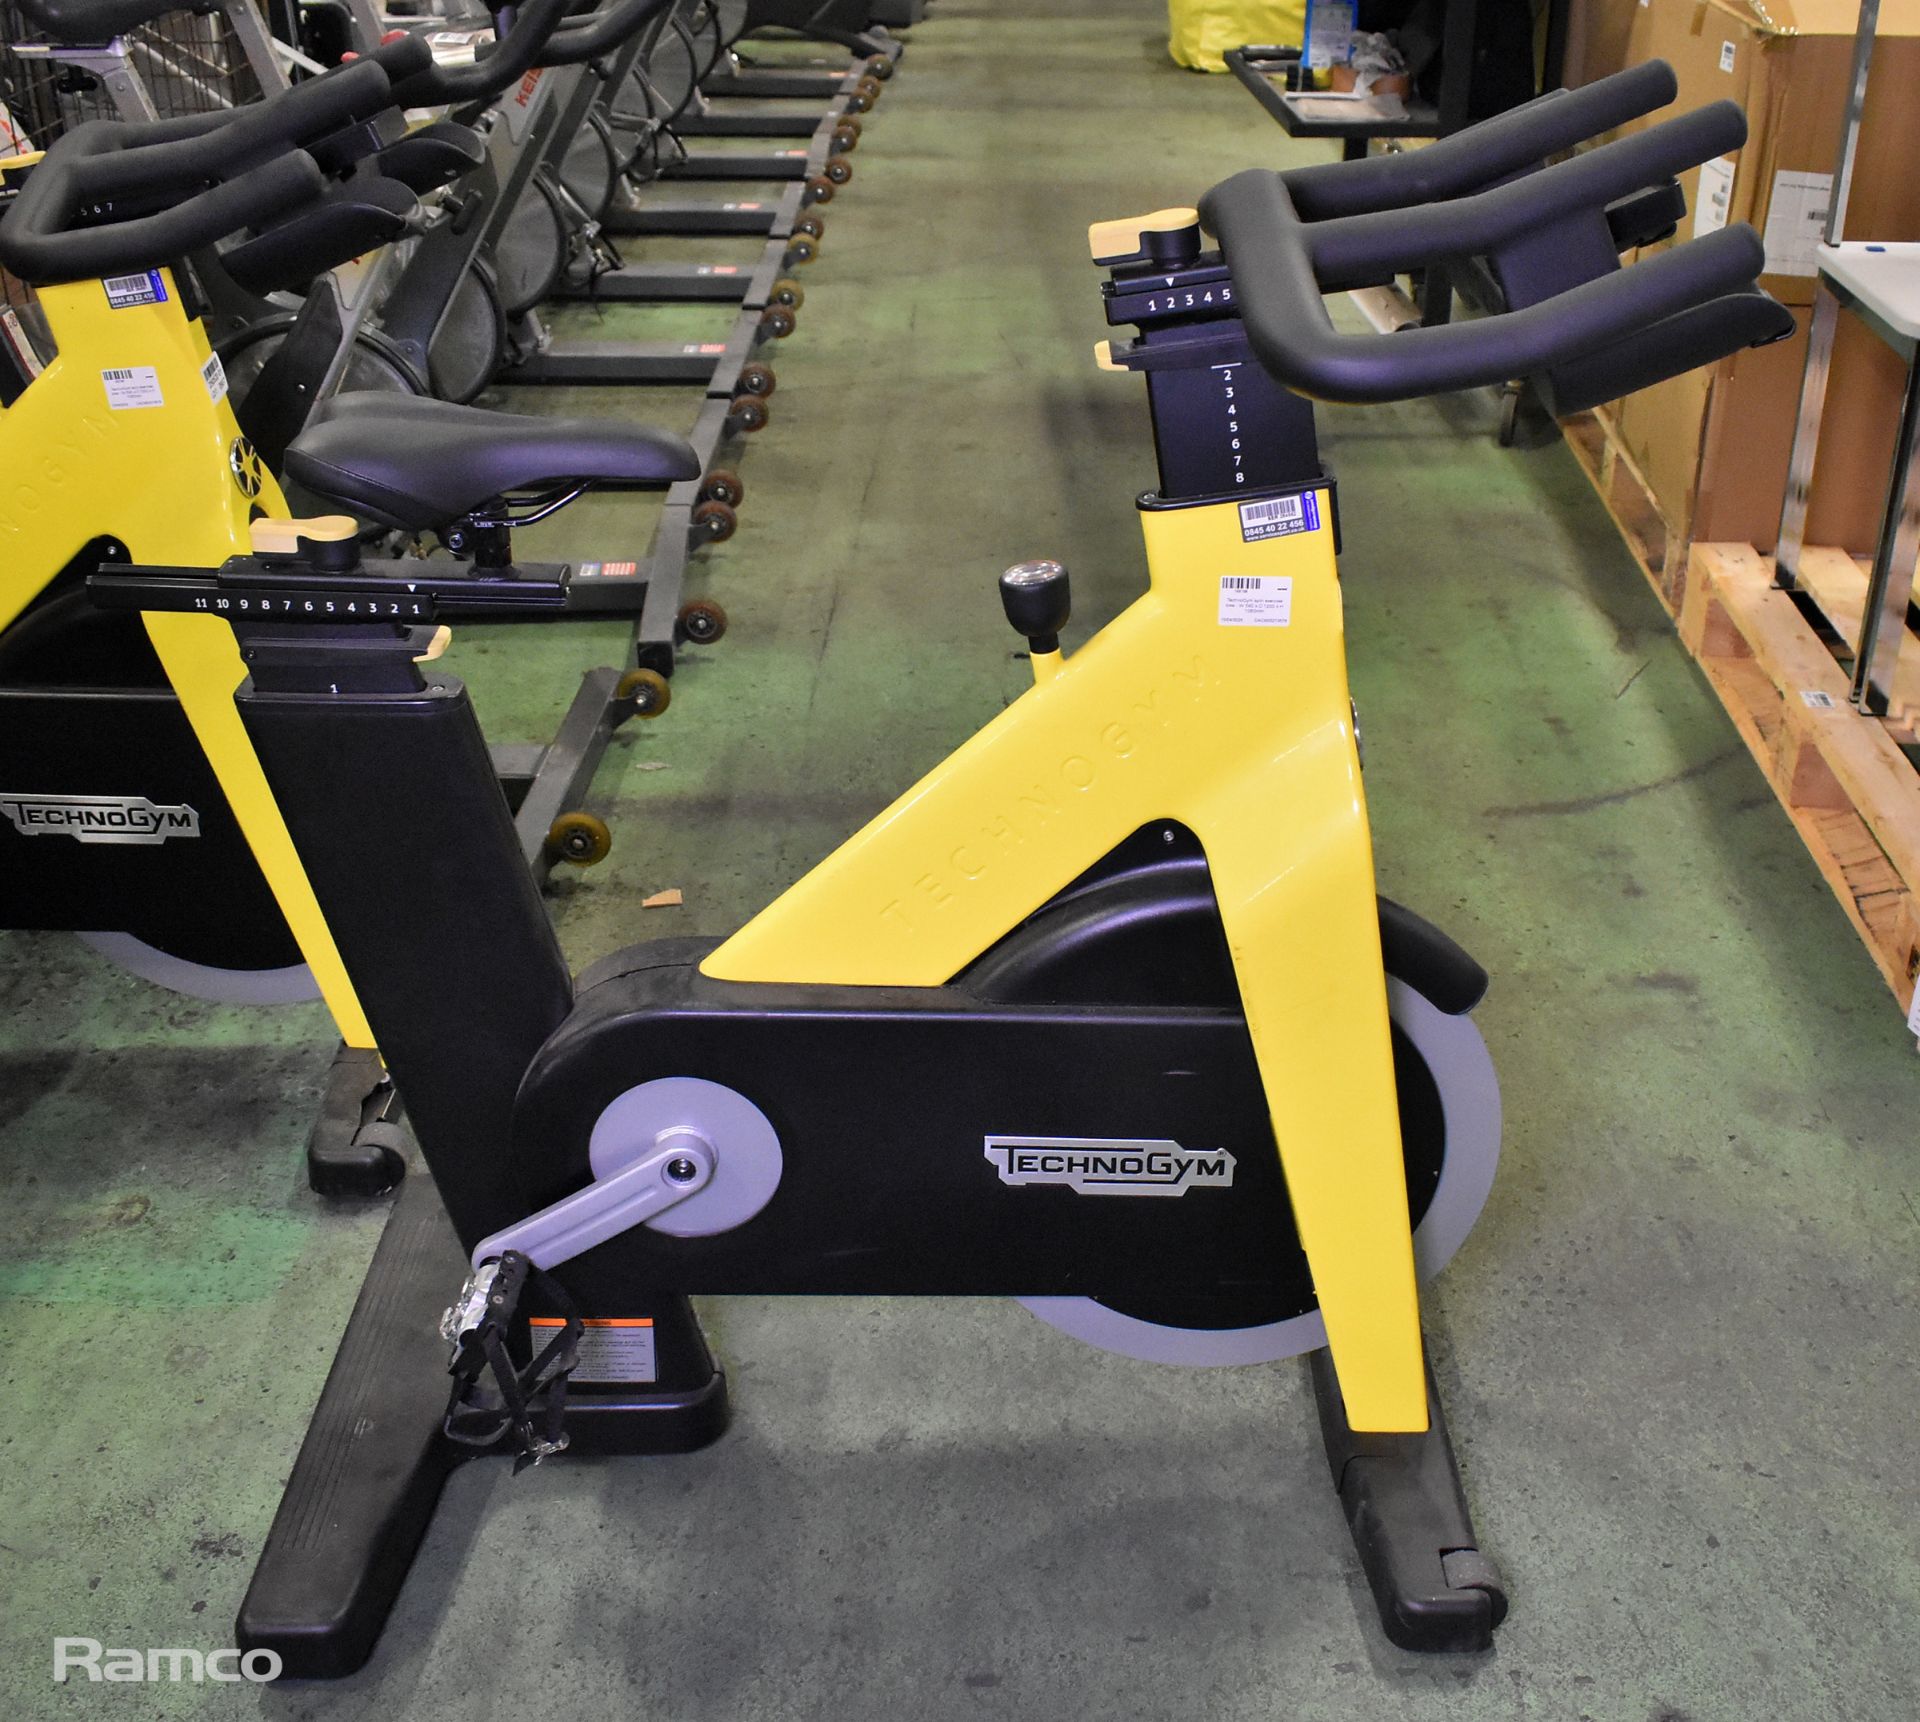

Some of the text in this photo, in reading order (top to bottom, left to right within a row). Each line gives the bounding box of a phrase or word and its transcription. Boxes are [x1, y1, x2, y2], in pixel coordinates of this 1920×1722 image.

[94, 204, 101, 214] 6
[106, 202, 113, 211] 7
[1148, 288, 1231, 311] 1 2 3 4 5
[1223, 369, 1232, 381] 2
[1225, 387, 1234, 398] 3
[1227, 404, 1237, 415] 4
[1229, 421, 1238, 432] 5
[1231, 438, 1240, 449] 6
[1233, 455, 1242, 466] 7
[1235, 472, 1244, 483] 8
[1244, 519, 1304, 537] 0845 40 22 456
[195, 598, 420, 614] 11 10 9 8 7 6 5 4 3 2 1
[329, 683, 338, 694] 1
